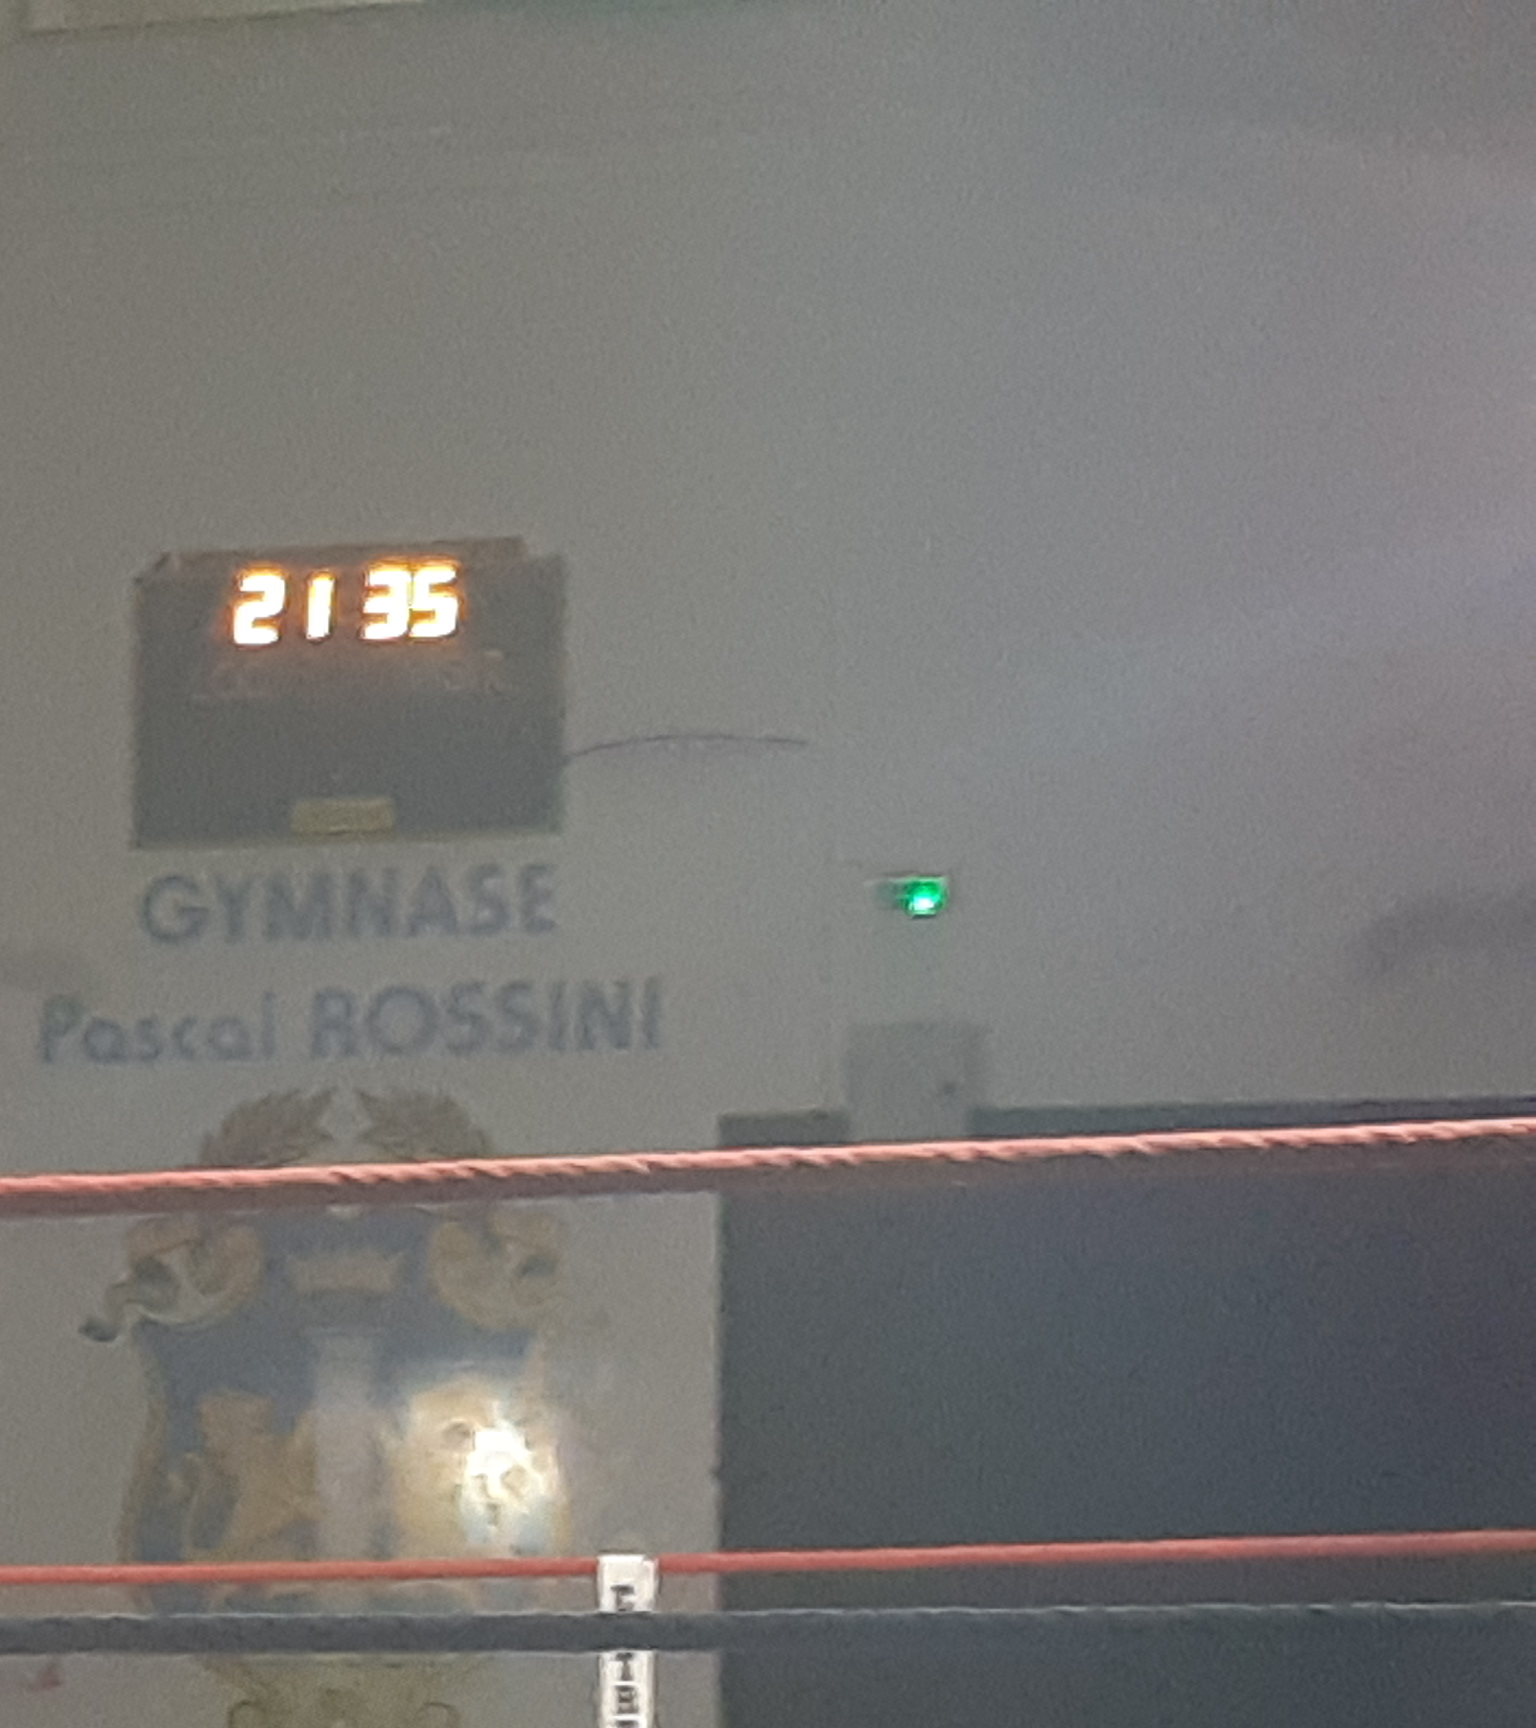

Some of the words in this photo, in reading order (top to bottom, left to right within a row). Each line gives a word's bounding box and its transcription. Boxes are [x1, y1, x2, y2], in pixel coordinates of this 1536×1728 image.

[360, 556, 462, 641] 35
[139, 861, 560, 945] GYMNASE
[37, 992, 276, 1065] Pascal
[307, 976, 664, 1059] ROSSINI
